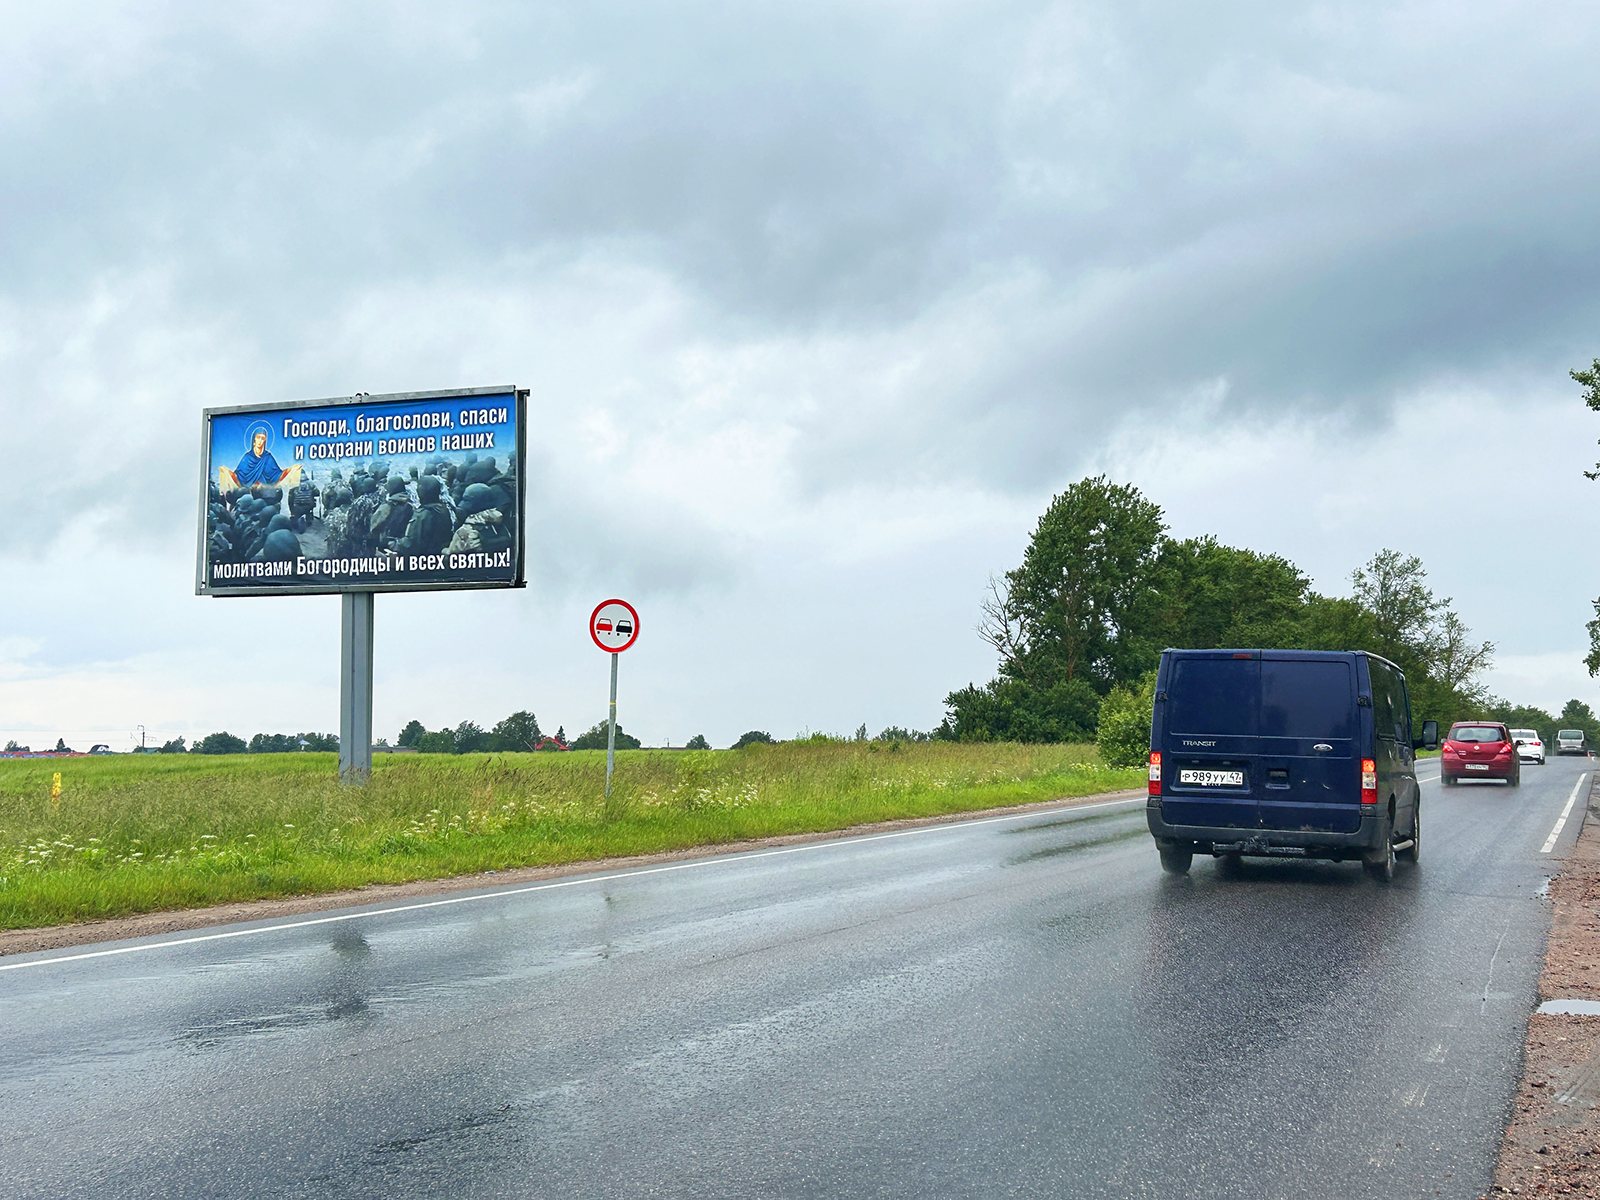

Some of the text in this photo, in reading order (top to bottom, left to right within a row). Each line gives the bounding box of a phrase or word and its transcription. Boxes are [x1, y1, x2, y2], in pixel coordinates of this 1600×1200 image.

[283, 408, 507, 438] Господи, благослови, спаси
[295, 432, 494, 461] и сохрани воинов наших
[213, 547, 511, 579] молитвами Богородицы и всех святых!
